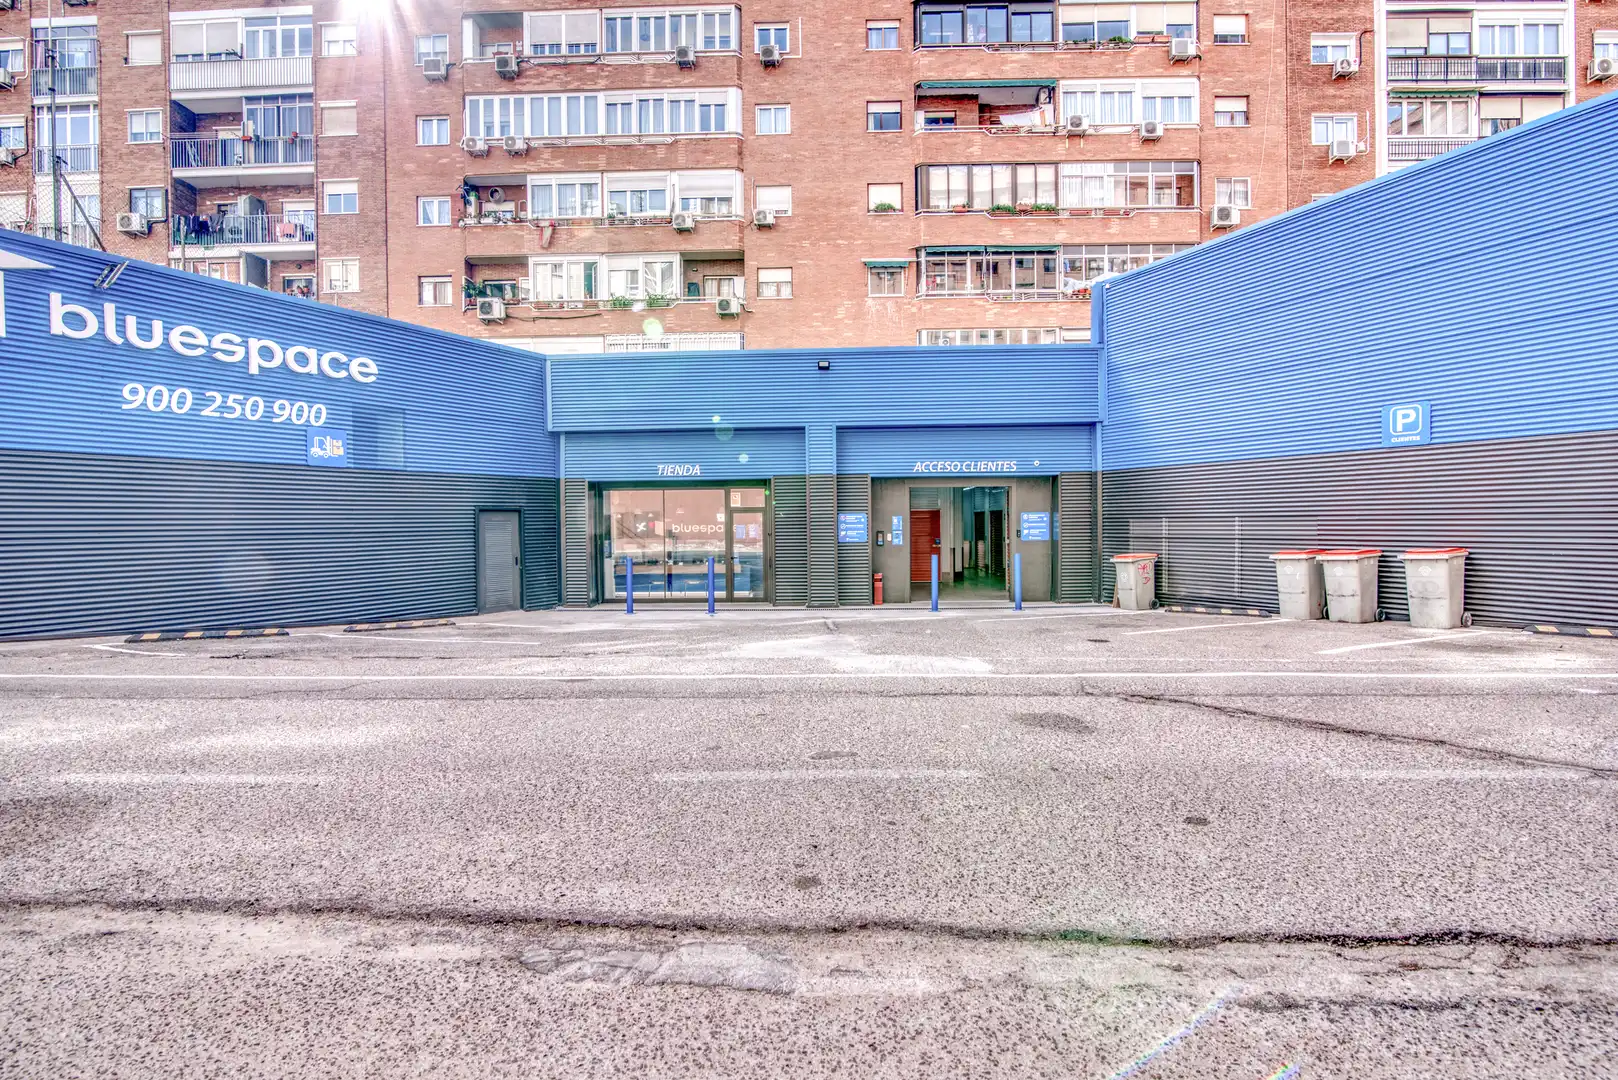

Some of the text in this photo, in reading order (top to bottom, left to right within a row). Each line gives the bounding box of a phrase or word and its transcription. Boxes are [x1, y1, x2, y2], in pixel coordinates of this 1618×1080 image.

[48, 291, 379, 383] bluespace
[121, 382, 327, 427] 900 250 900
[1396, 409, 1417, 432] P
[657, 464, 701, 476] TIENDA
[912, 460, 1017, 473] ACCESO CLIENTES
[671, 523, 737, 535] bluespa
